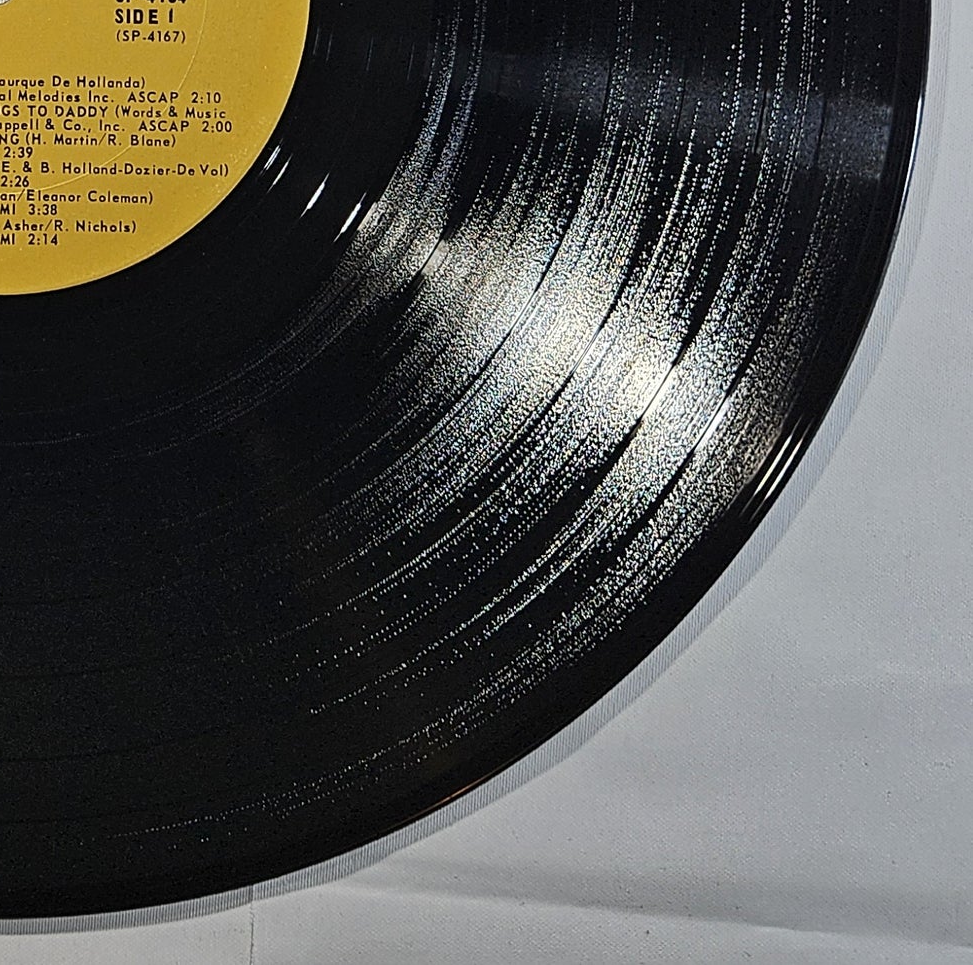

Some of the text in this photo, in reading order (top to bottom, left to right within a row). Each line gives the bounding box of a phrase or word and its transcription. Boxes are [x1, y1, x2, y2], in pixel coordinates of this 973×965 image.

[115, 9, 158, 24] SIDE
[117, 30, 185, 43] (SP-4167)
[53, 76, 70, 87] De
[77, 76, 145, 89] Hollanda)
[18, 90, 80, 102] Melodies
[89, 90, 113, 102] Inc.
[128, 91, 178, 103] ASCAP
[192, 92, 221, 103] 2:10
[27, 105, 47, 117] TO
[55, 106, 108, 117] DADDY
[116, 105, 161, 118] (Words
[169, 106, 177, 117] &
[186, 107, 225, 118] Music
[45, 118, 54, 130] &
[64, 119, 91, 132] Co.,
[100, 120, 124, 131] Inc.
[139, 120, 189, 131] ASCAP
[202, 121, 232, 133] 2:00
[26, 132, 46, 145] (H.
[54, 133, 121, 145] Martin/R.
[131, 135, 175, 147] Blane)
[4, 146, 33, 158] 2:39
[23, 161, 32, 172] &
[41, 162, 54, 173] B.
[1, 175, 29, 187] 2:26
[88, 191, 152, 204] Coleman)
[29, 204, 57, 215] 3:38
[4, 219, 68, 231] Asher/R.
[76, 220, 136, 233] Nichols)
[28, 233, 57, 245] 2:14
